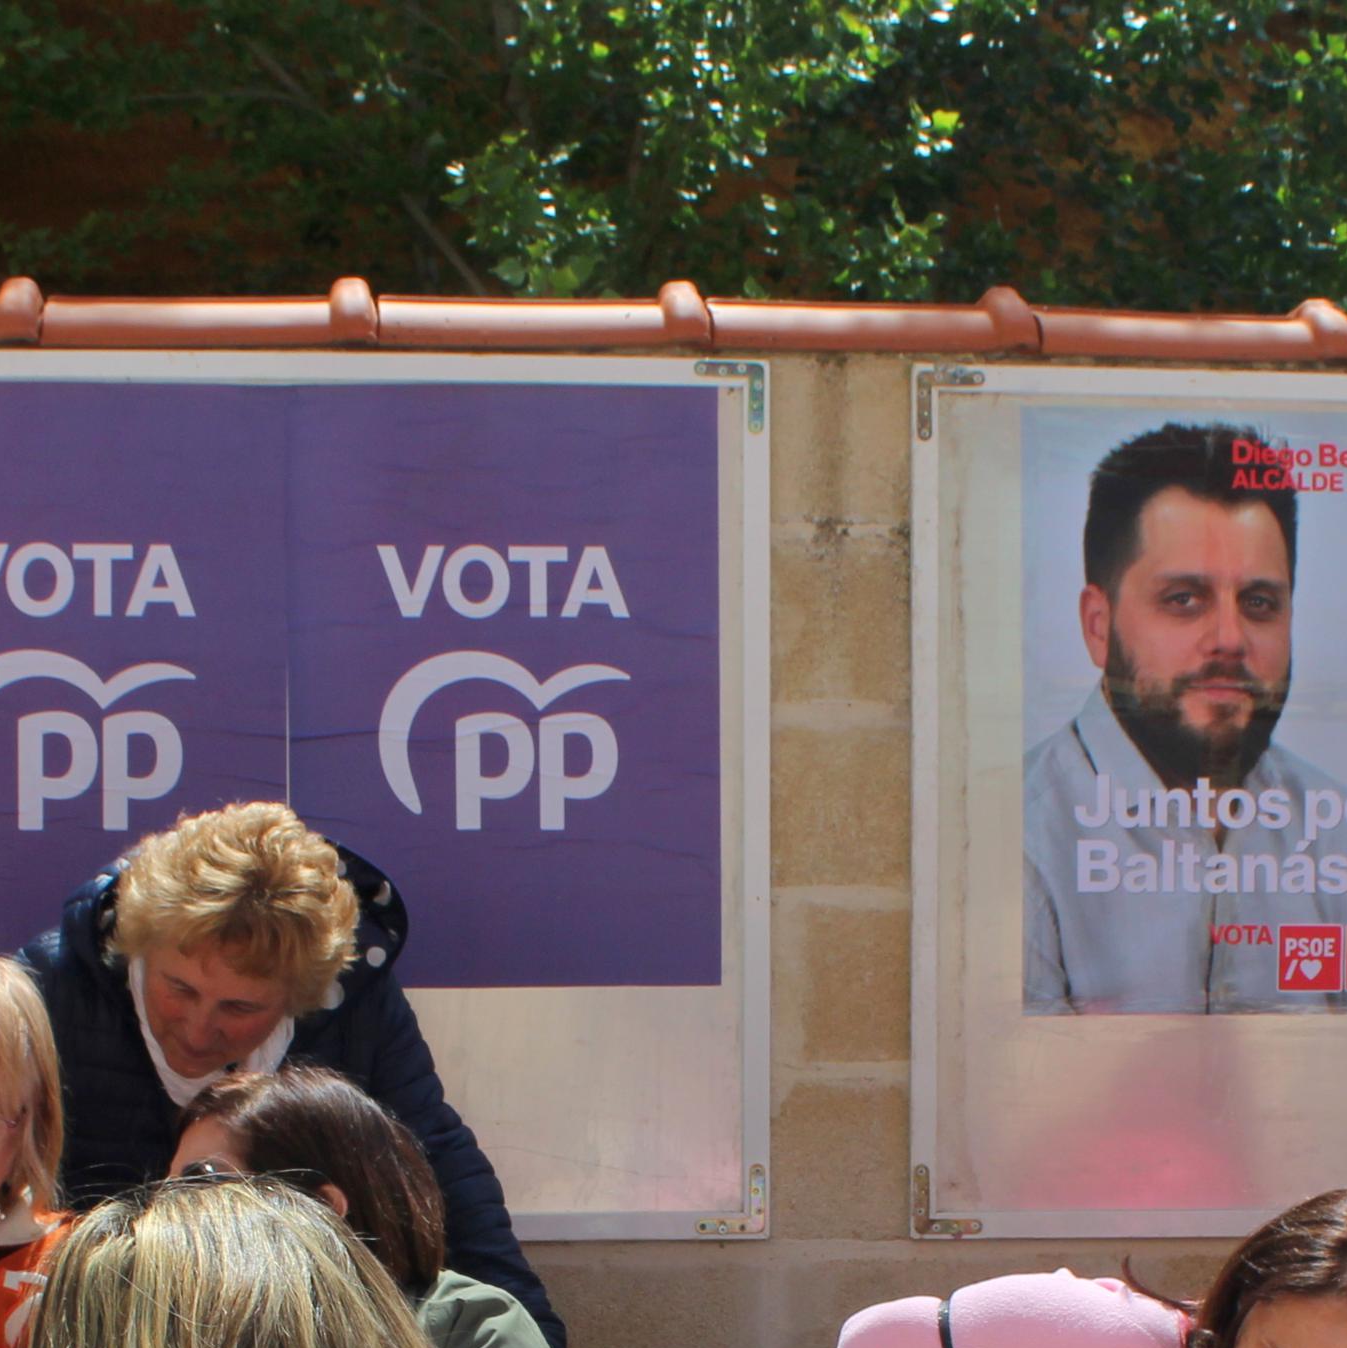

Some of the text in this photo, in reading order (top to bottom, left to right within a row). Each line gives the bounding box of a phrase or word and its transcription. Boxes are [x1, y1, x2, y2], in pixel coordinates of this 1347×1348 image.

[1231, 438, 1313, 471] Diego
[1231, 467, 1344, 493] ALCALDE
[377, 544, 631, 619] VOTA
[1074, 773, 1292, 830] Juntos
[1209, 923, 1336, 958] VOTA PSOE
